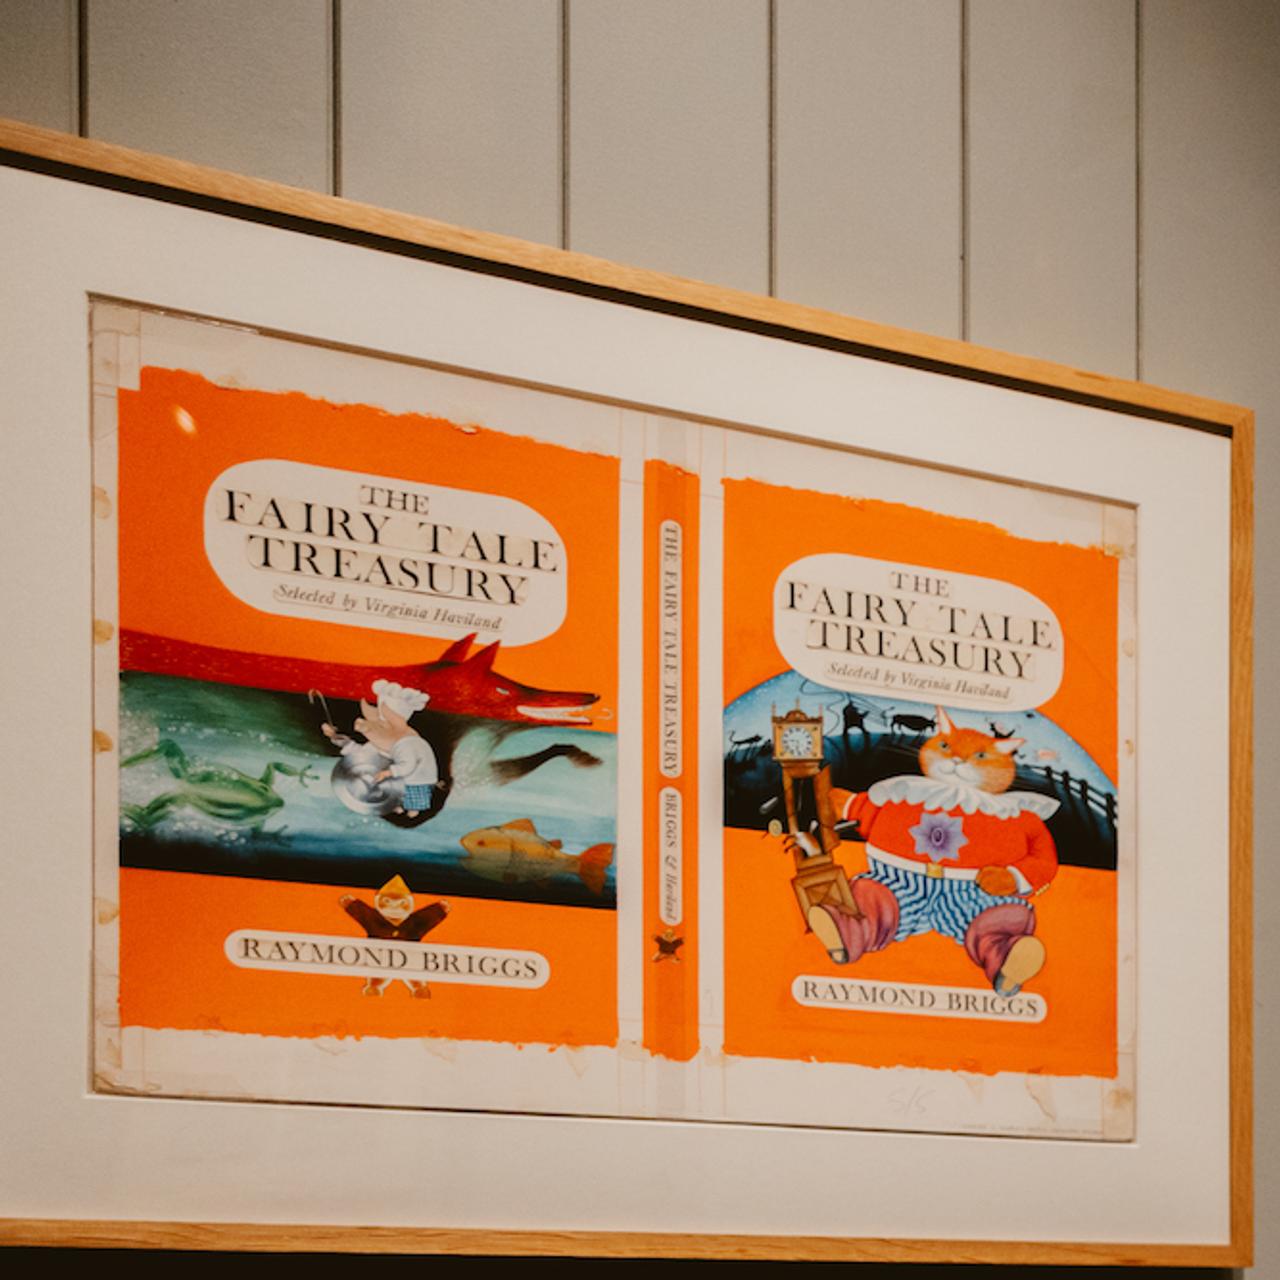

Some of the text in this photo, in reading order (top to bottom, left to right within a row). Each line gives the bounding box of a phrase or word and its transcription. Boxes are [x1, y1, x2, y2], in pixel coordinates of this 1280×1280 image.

[361, 484, 430, 516] THE
[224, 489, 558, 573] FAIRY TALE
[247, 534, 528, 605] TREASURY
[891, 571, 950, 598] THE
[277, 584, 503, 630] Selected by Virginia Haviland
[788, 582, 1053, 650] FAIRY TALE
[664, 526, 678, 773] THE FAIRY TALE TREASURY
[809, 619, 1032, 679] TREASURY
[827, 662, 1011, 700] Selected by Virginia Haviland
[665, 793, 678, 848] BRIGGS
[241, 938, 539, 979] RAYMOND BRIGGS
[803, 980, 1038, 1016] RAYMOND BRIGGS
